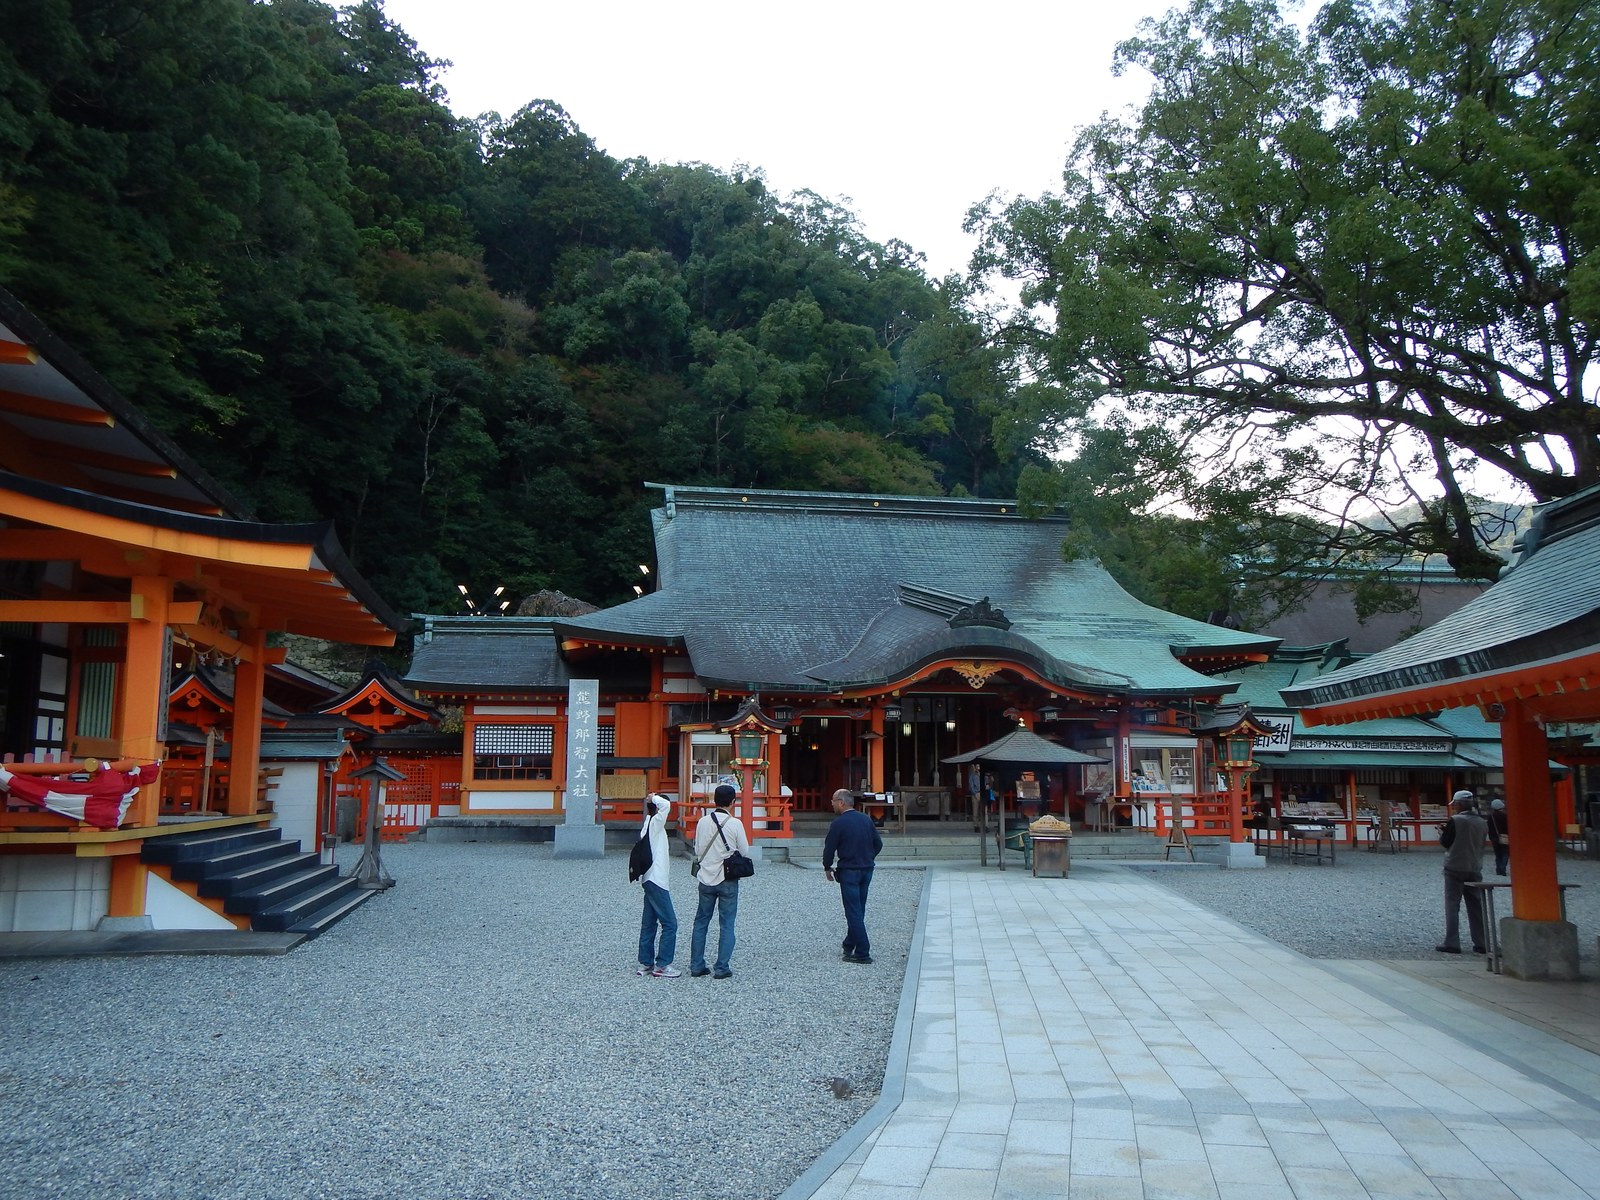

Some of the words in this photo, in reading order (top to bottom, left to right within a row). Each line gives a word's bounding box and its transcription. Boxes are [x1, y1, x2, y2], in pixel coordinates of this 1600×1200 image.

[573, 691, 591, 797] 熊野那智大社
